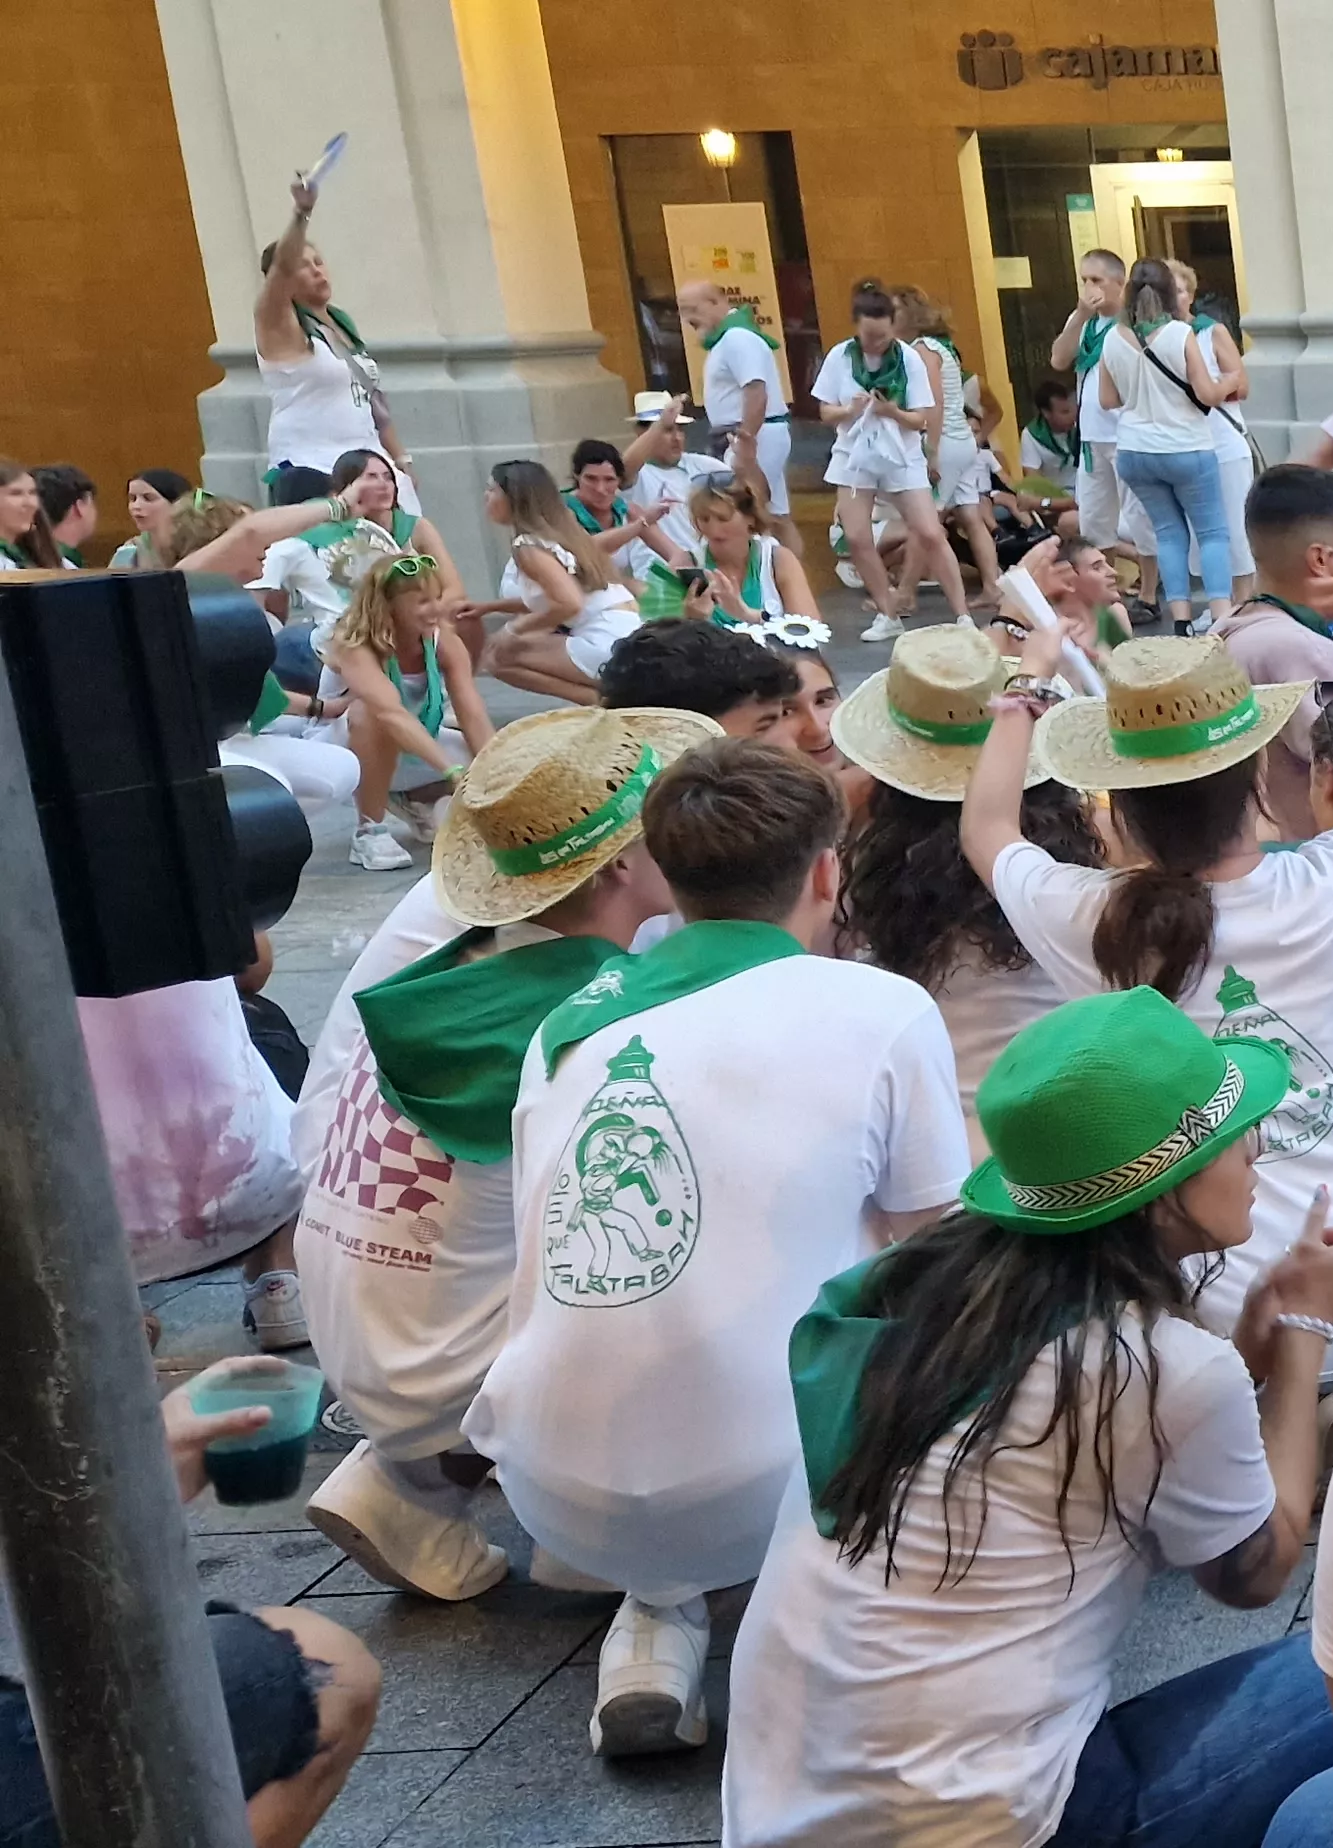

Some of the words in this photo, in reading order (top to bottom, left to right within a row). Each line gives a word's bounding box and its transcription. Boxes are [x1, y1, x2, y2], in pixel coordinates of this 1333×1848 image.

[1040, 33, 1221, 90] cajama
[335, 1230, 363, 1251] BLUE
[365, 1241, 433, 1265] STEAM
[547, 1234, 571, 1257] QUE
